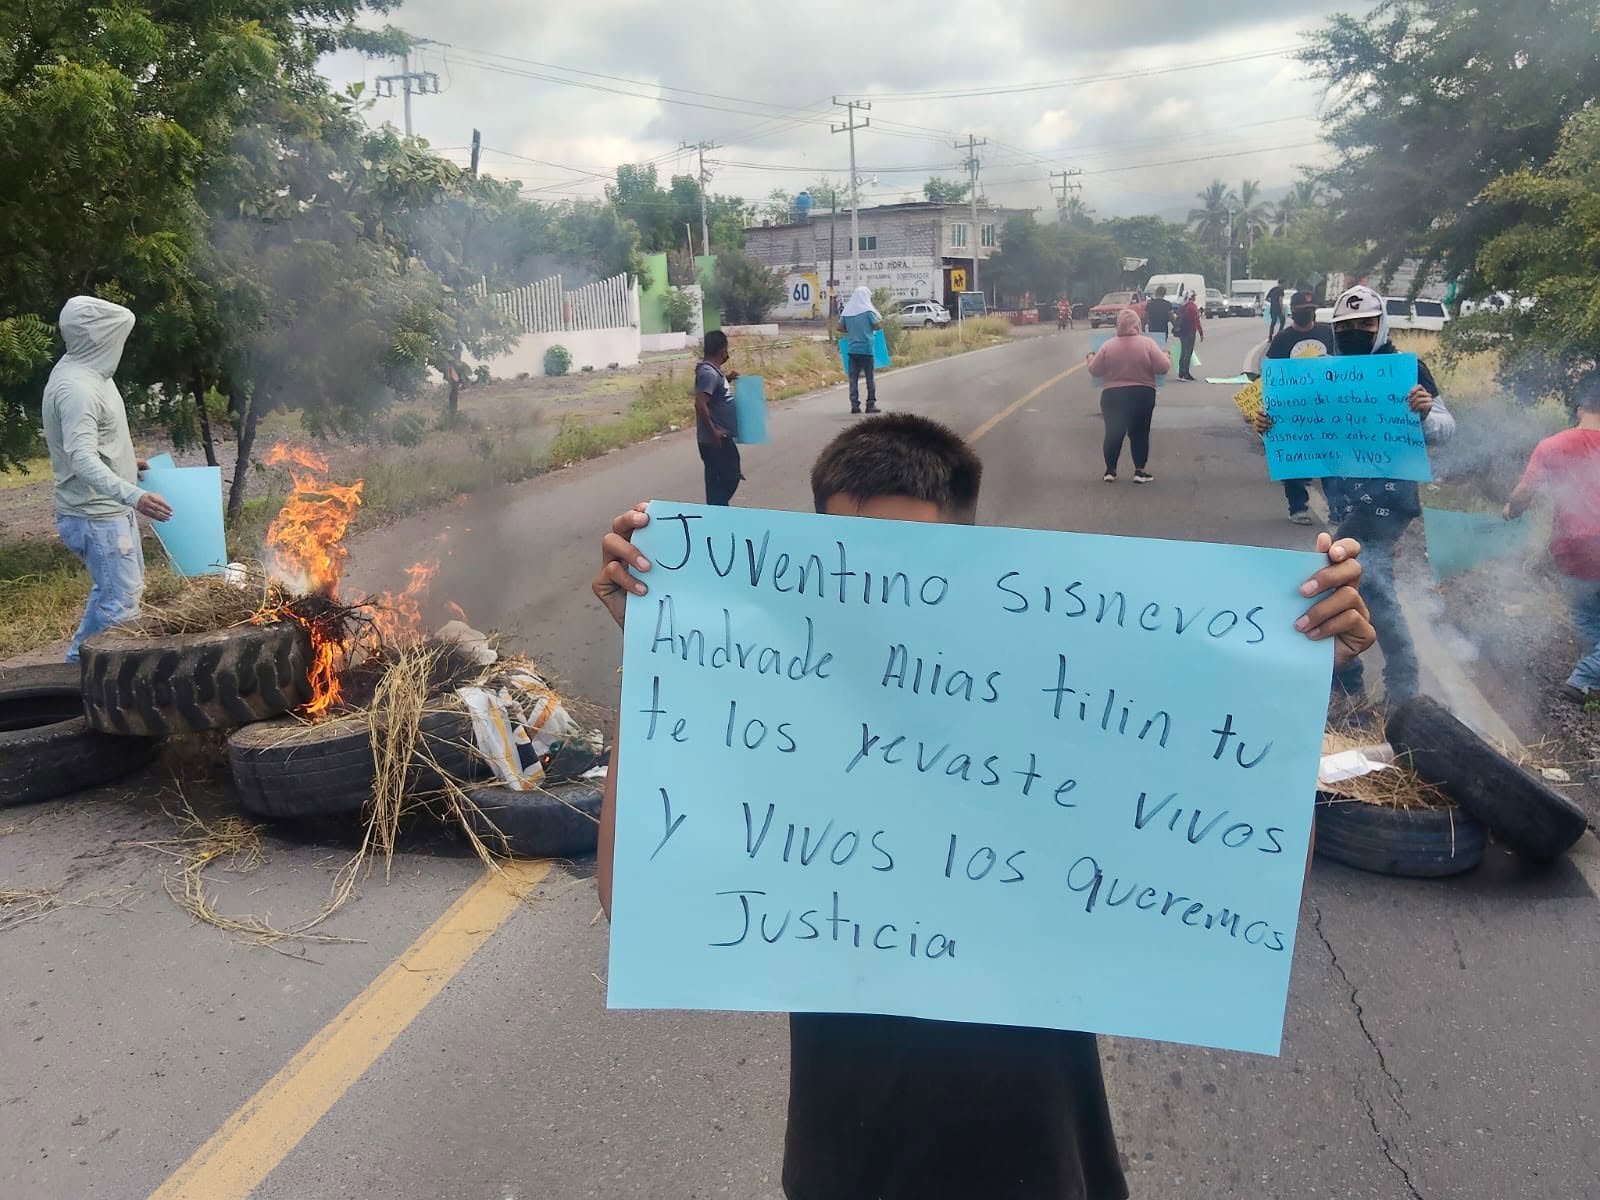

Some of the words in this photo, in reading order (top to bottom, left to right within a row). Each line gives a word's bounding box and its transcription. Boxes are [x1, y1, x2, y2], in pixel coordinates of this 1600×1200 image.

[793, 283, 810, 301] 60
[1265, 366, 1314, 387] Pedimos
[1325, 365, 1365, 382] ayuda
[1377, 363, 1393, 378] al
[1337, 390, 1377, 405] estado
[1292, 410, 1325, 428] ayude
[1345, 413, 1367, 427] que
[1346, 430, 1377, 441] entre
[651, 595, 833, 680] Andrade
[881, 644, 1001, 703] Alias
[1041, 654, 1171, 748] tilin
[1211, 714, 1273, 769] tu
[639, 676, 689, 742] te
[726, 701, 796, 753] los
[944, 833, 1026, 884] los
[1066, 856, 1285, 952] queremos
[707, 891, 956, 959] Justicia
